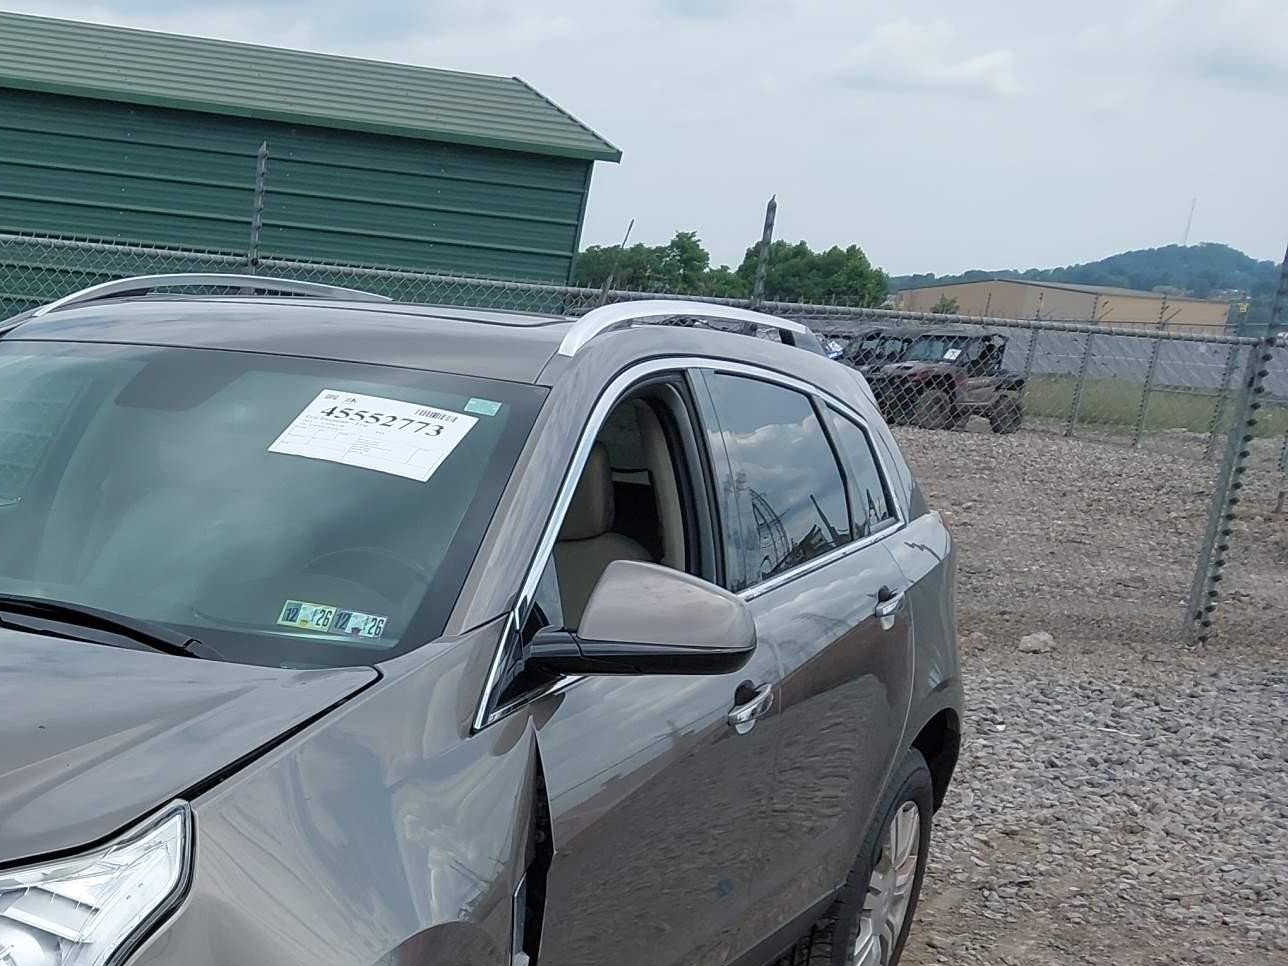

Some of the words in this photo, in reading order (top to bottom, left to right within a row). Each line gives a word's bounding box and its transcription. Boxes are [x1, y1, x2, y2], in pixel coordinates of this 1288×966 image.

[321, 405, 445, 437] 45552773
[286, 607, 300, 622] 12
[316, 609, 333, 627] 26
[334, 612, 352, 630] 12
[367, 617, 385, 636] 26
